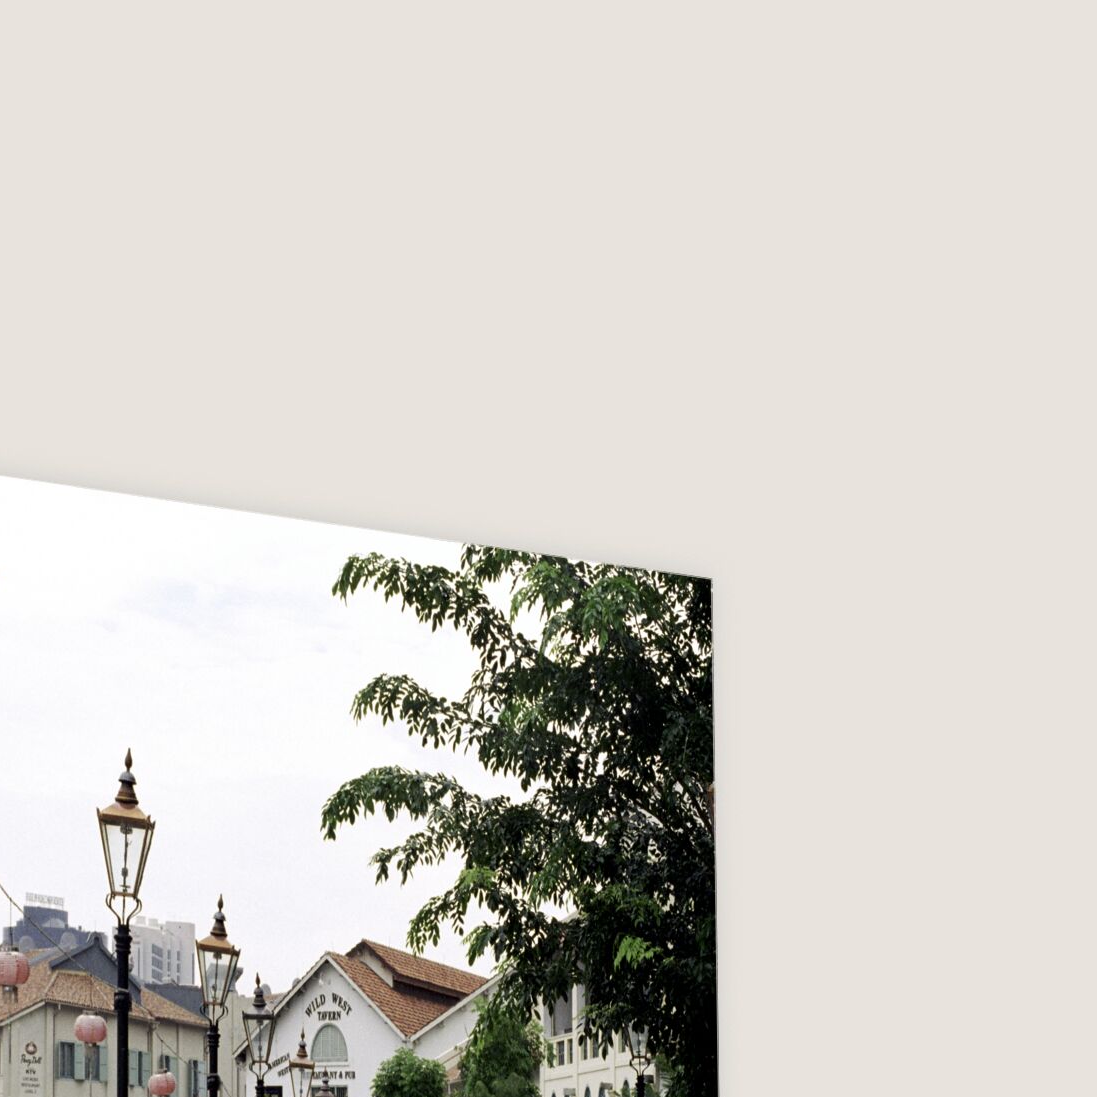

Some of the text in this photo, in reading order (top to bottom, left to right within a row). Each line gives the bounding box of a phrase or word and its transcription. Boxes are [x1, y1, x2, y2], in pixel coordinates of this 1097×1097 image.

[305, 992, 352, 1018] WILD WEST
[317, 1010, 342, 1021] TAVERN
[344, 1071, 356, 1080] PUB
